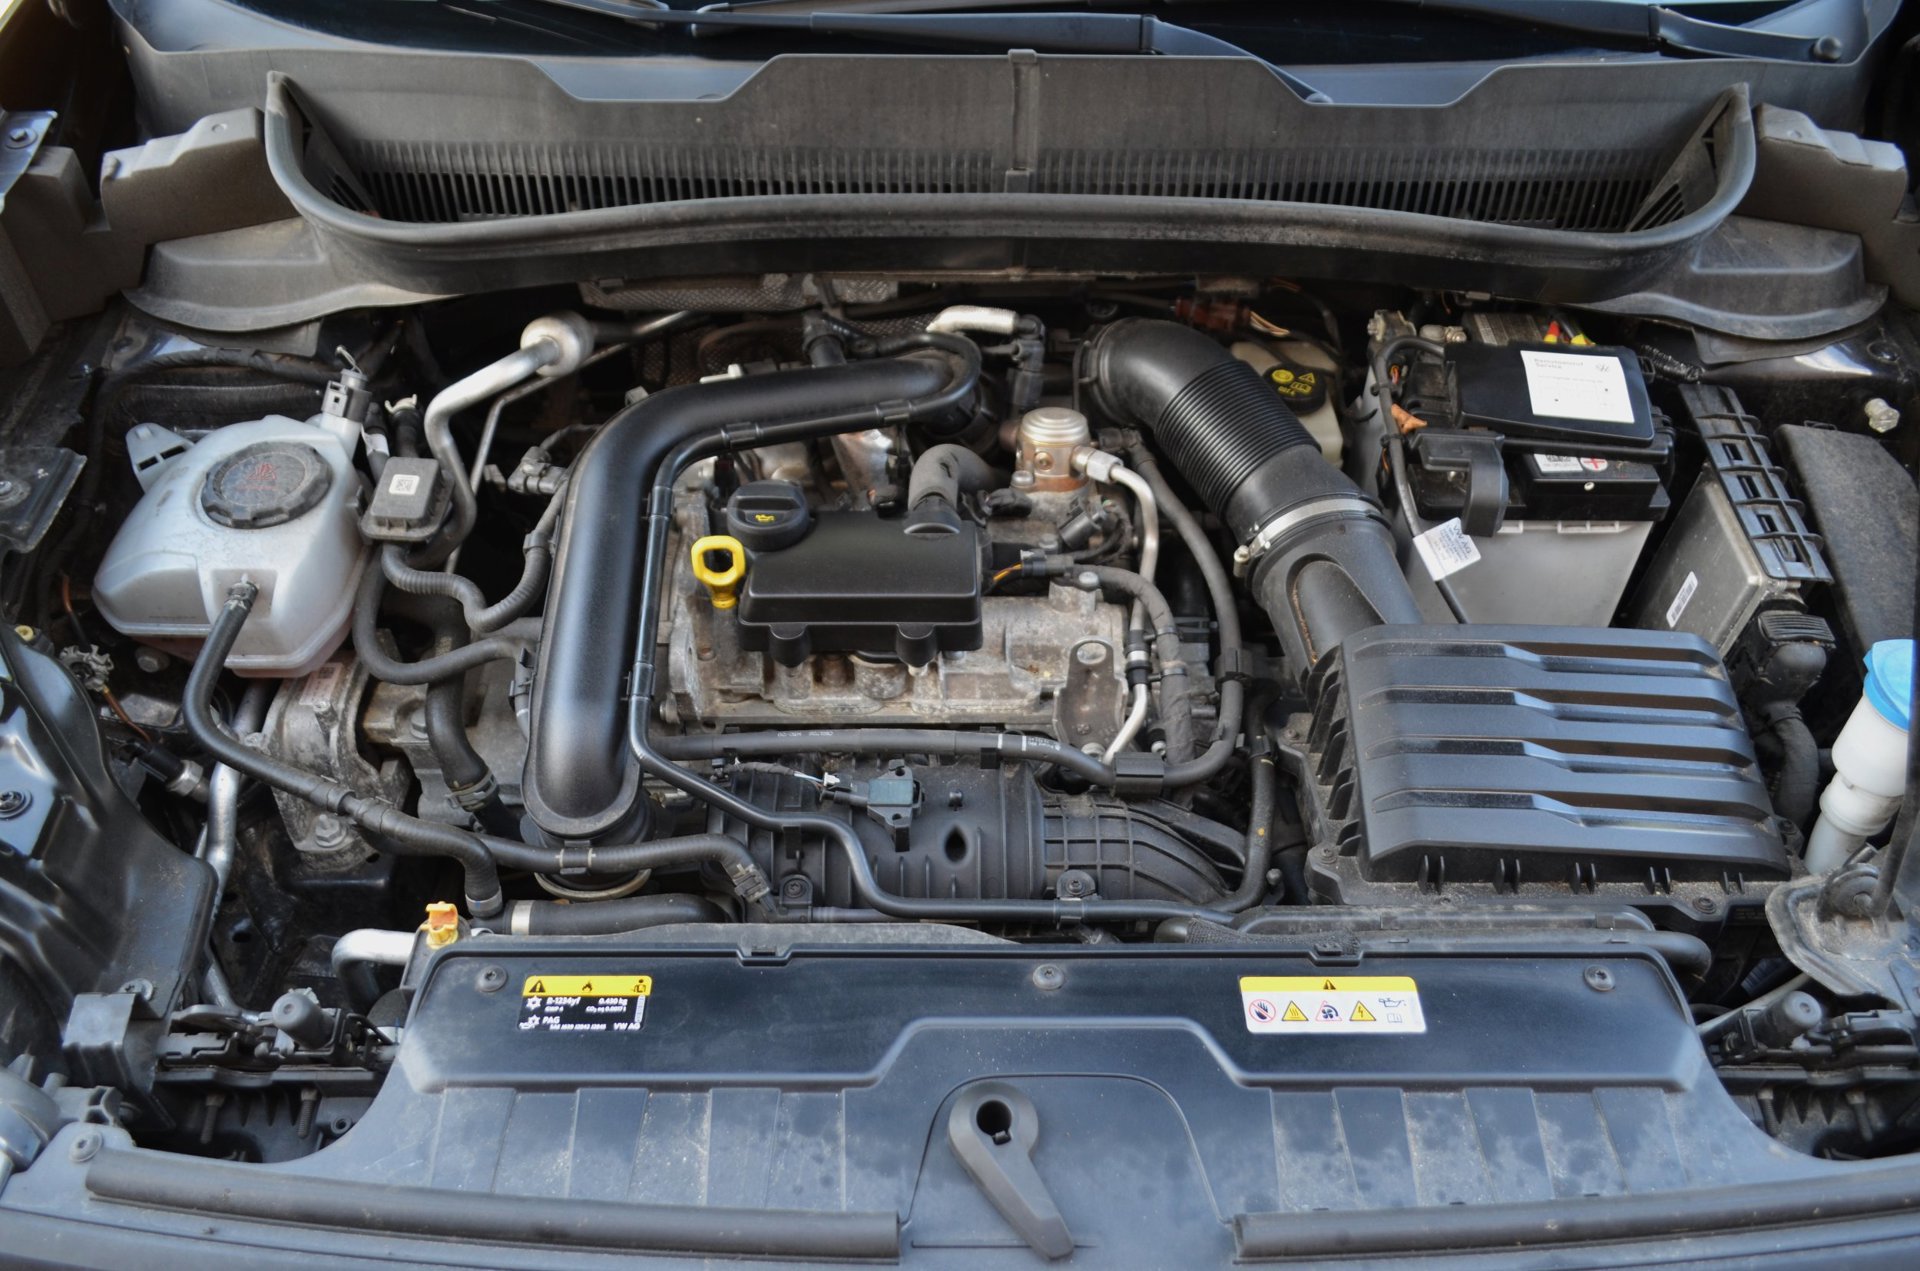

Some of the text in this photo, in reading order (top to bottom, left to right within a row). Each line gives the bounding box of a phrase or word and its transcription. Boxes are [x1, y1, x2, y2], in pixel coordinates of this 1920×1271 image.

[546, 996, 581, 1007] R-1234yf
[618, 997, 628, 1006] kg
[542, 1016, 560, 1024] PAG
[613, 1022, 641, 1031] VW AG
